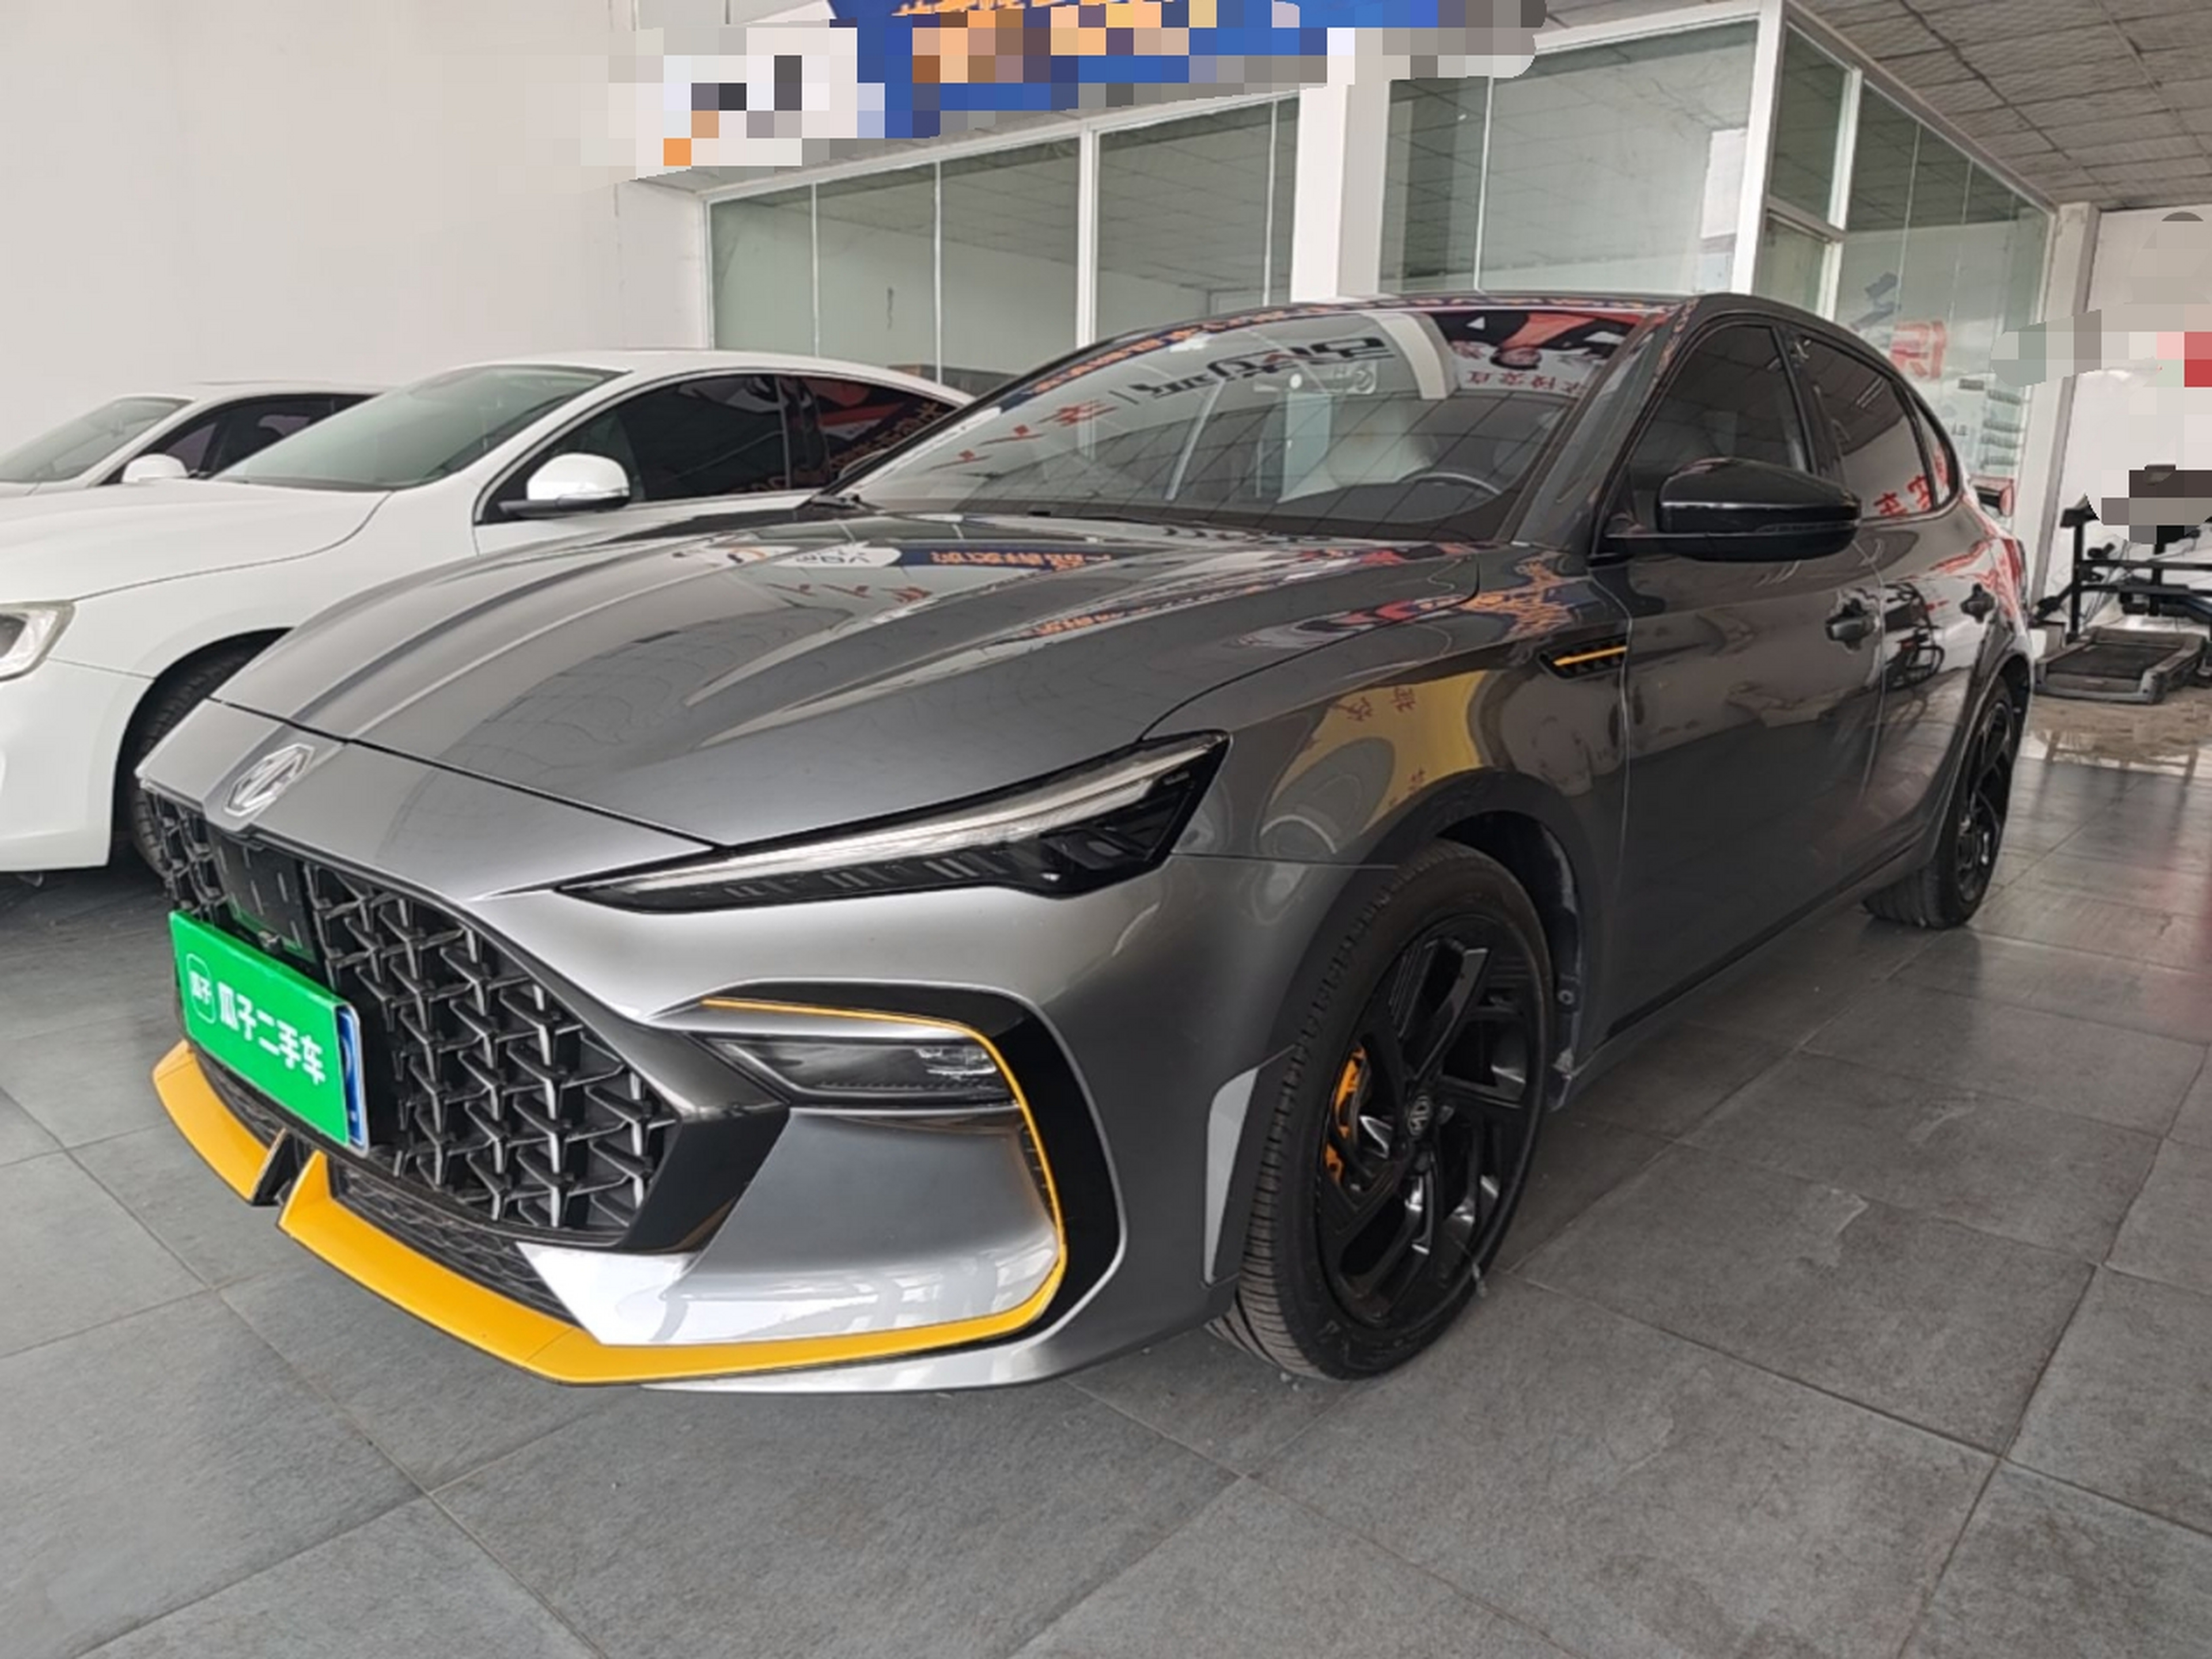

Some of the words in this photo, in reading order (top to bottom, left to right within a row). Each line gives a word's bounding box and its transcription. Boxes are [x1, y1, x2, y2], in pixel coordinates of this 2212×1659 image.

[217, 980, 327, 1086] 瓜子二手车
